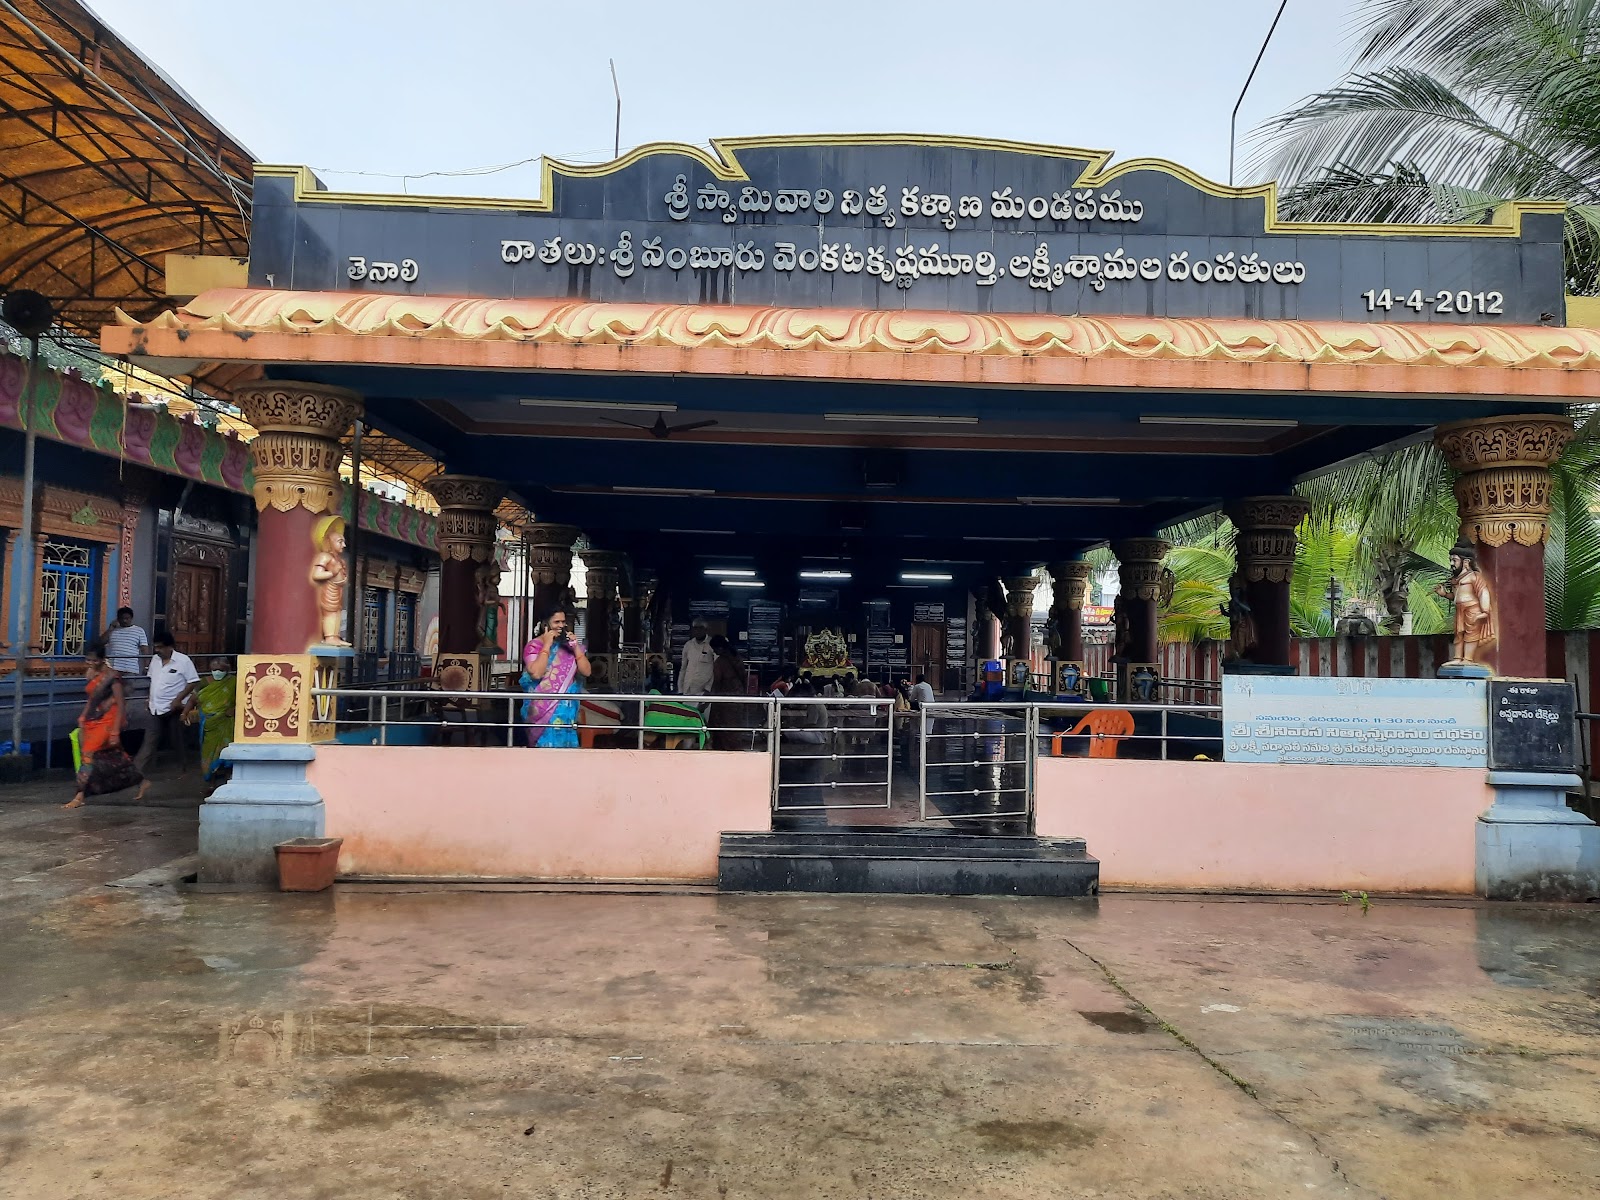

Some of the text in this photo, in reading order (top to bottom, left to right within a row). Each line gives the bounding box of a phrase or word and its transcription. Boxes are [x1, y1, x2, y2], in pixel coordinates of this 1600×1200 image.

[664, 173, 1145, 230] శ్రీ స్వామివారి నిత్య కళ్యాణ మండపము
[346, 256, 419, 283] తెనాలి
[609, 230, 635, 278] శ్రీ
[641, 236, 765, 271] నంబూరు
[1167, 250, 1307, 284] దంపతులు
[1361, 288, 1504, 314] 14-4-2012
[1499, 708, 1534, 723] అన్నదానం
